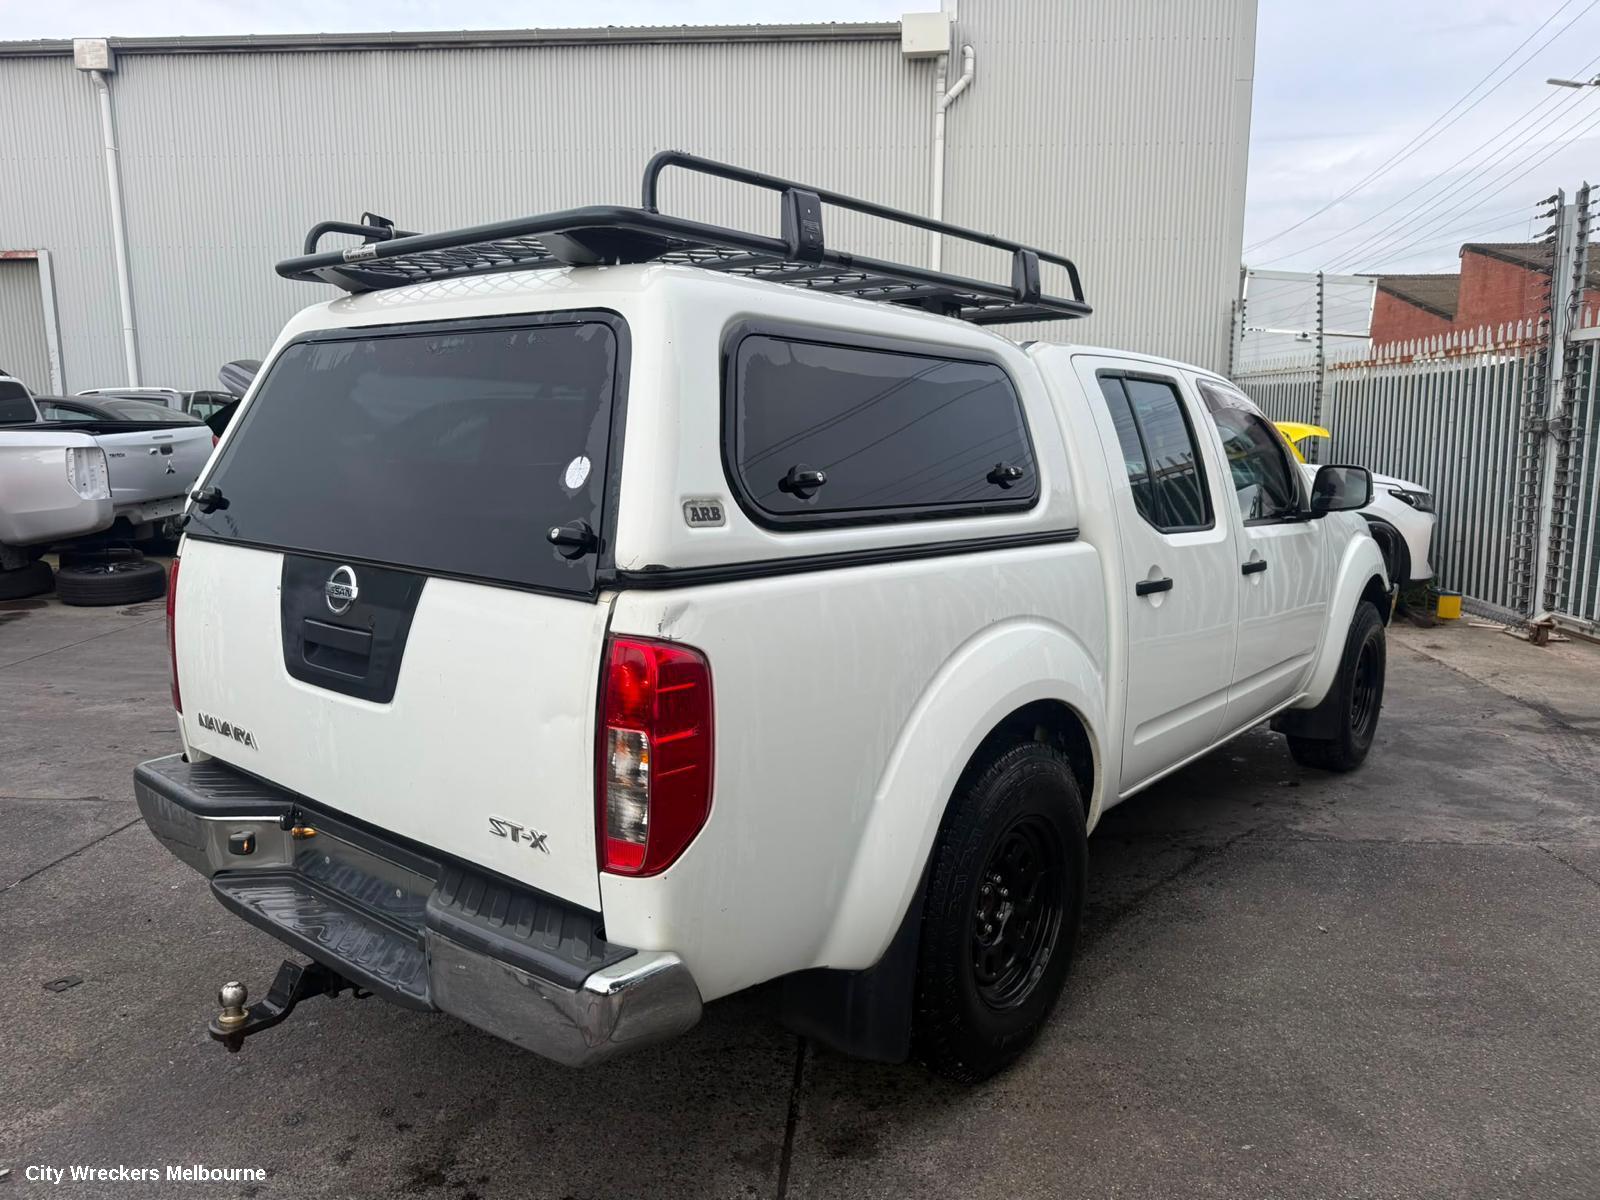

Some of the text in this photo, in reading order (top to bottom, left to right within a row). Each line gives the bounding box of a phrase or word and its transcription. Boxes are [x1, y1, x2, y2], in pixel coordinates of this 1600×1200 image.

[690, 506, 721, 522] ARB
[198, 712, 259, 751] NAVARA
[488, 816, 551, 855] ST-X
